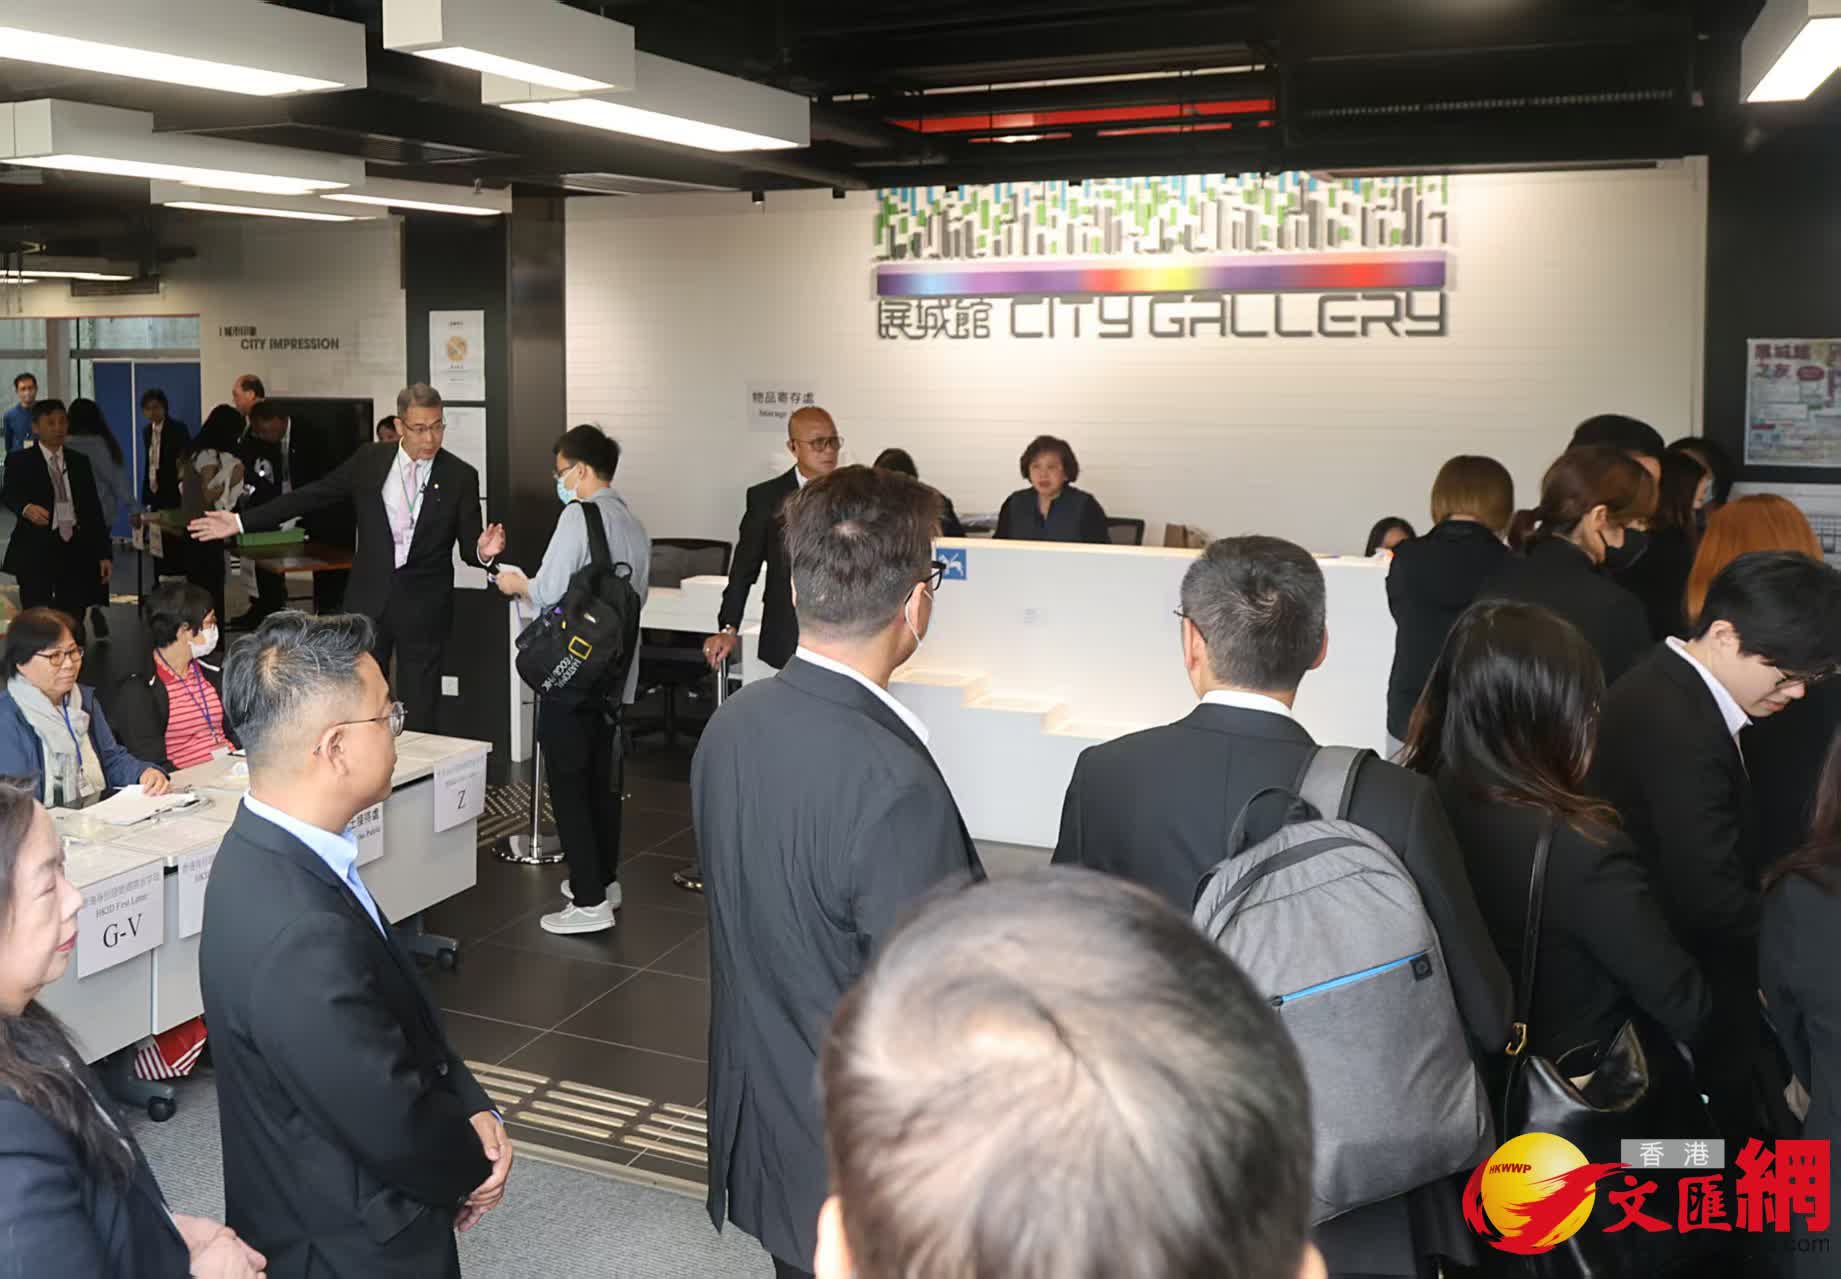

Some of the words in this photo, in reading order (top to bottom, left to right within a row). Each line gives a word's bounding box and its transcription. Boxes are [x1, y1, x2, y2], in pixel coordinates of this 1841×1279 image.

[876, 298, 992, 339] 展城館
[1010, 295, 1133, 339] CITY
[1149, 292, 1448, 338] GALLERY
[240, 338, 265, 350] CITY
[269, 337, 340, 350] IMPRESSION
[456, 789, 466, 810] Z
[102, 912, 143, 949] G-V
